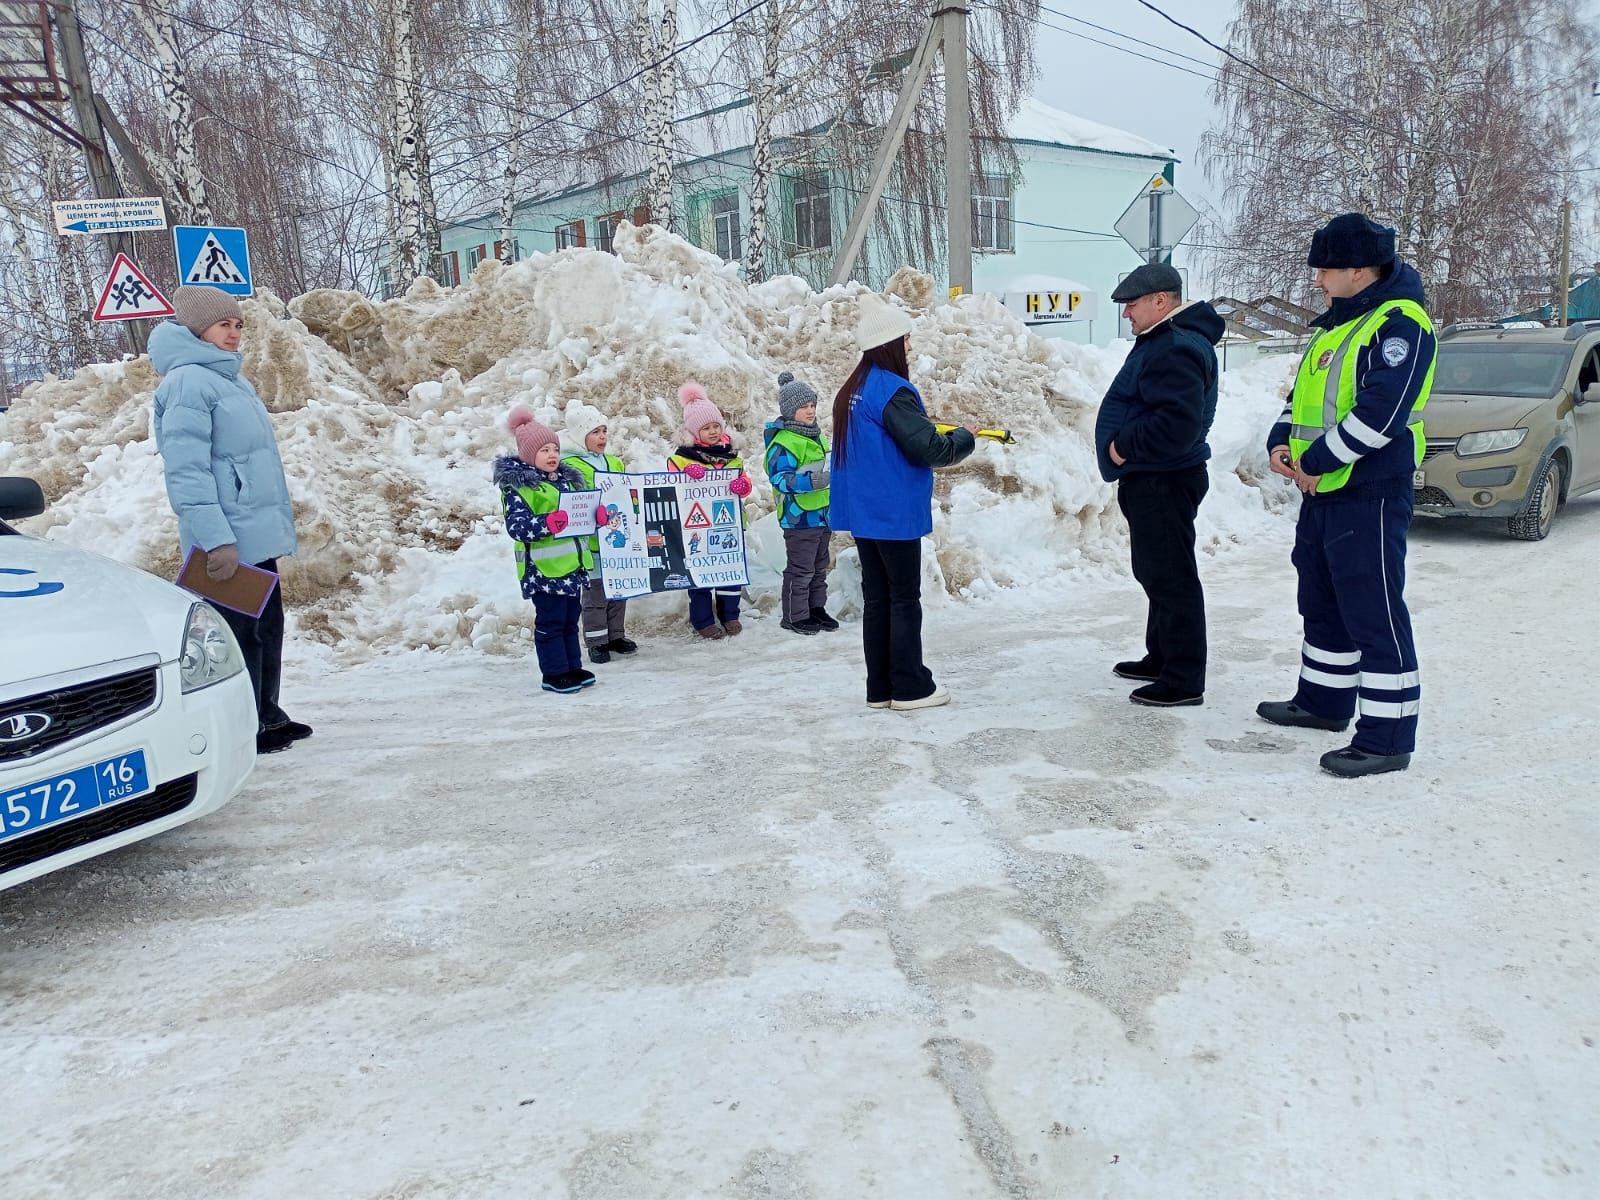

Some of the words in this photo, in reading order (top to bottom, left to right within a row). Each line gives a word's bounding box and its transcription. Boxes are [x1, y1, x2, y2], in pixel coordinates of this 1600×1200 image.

[67, 212, 98, 220] ЦЕМЕНТ
[123, 209, 153, 217] КРОВЛЯ
[1026, 293, 1081, 312] НУР
[621, 475, 632, 486] ЗА
[643, 469, 733, 486] БЕЗОПНЫЕ
[684, 485, 732, 502] ДОРОГИ
[709, 534, 721, 546] 02
[685, 551, 744, 569] СОХРАНИ
[614, 577, 648, 590] ВСЕМ
[102, 758, 135, 787] 16
[108, 783, 133, 799] RUS
